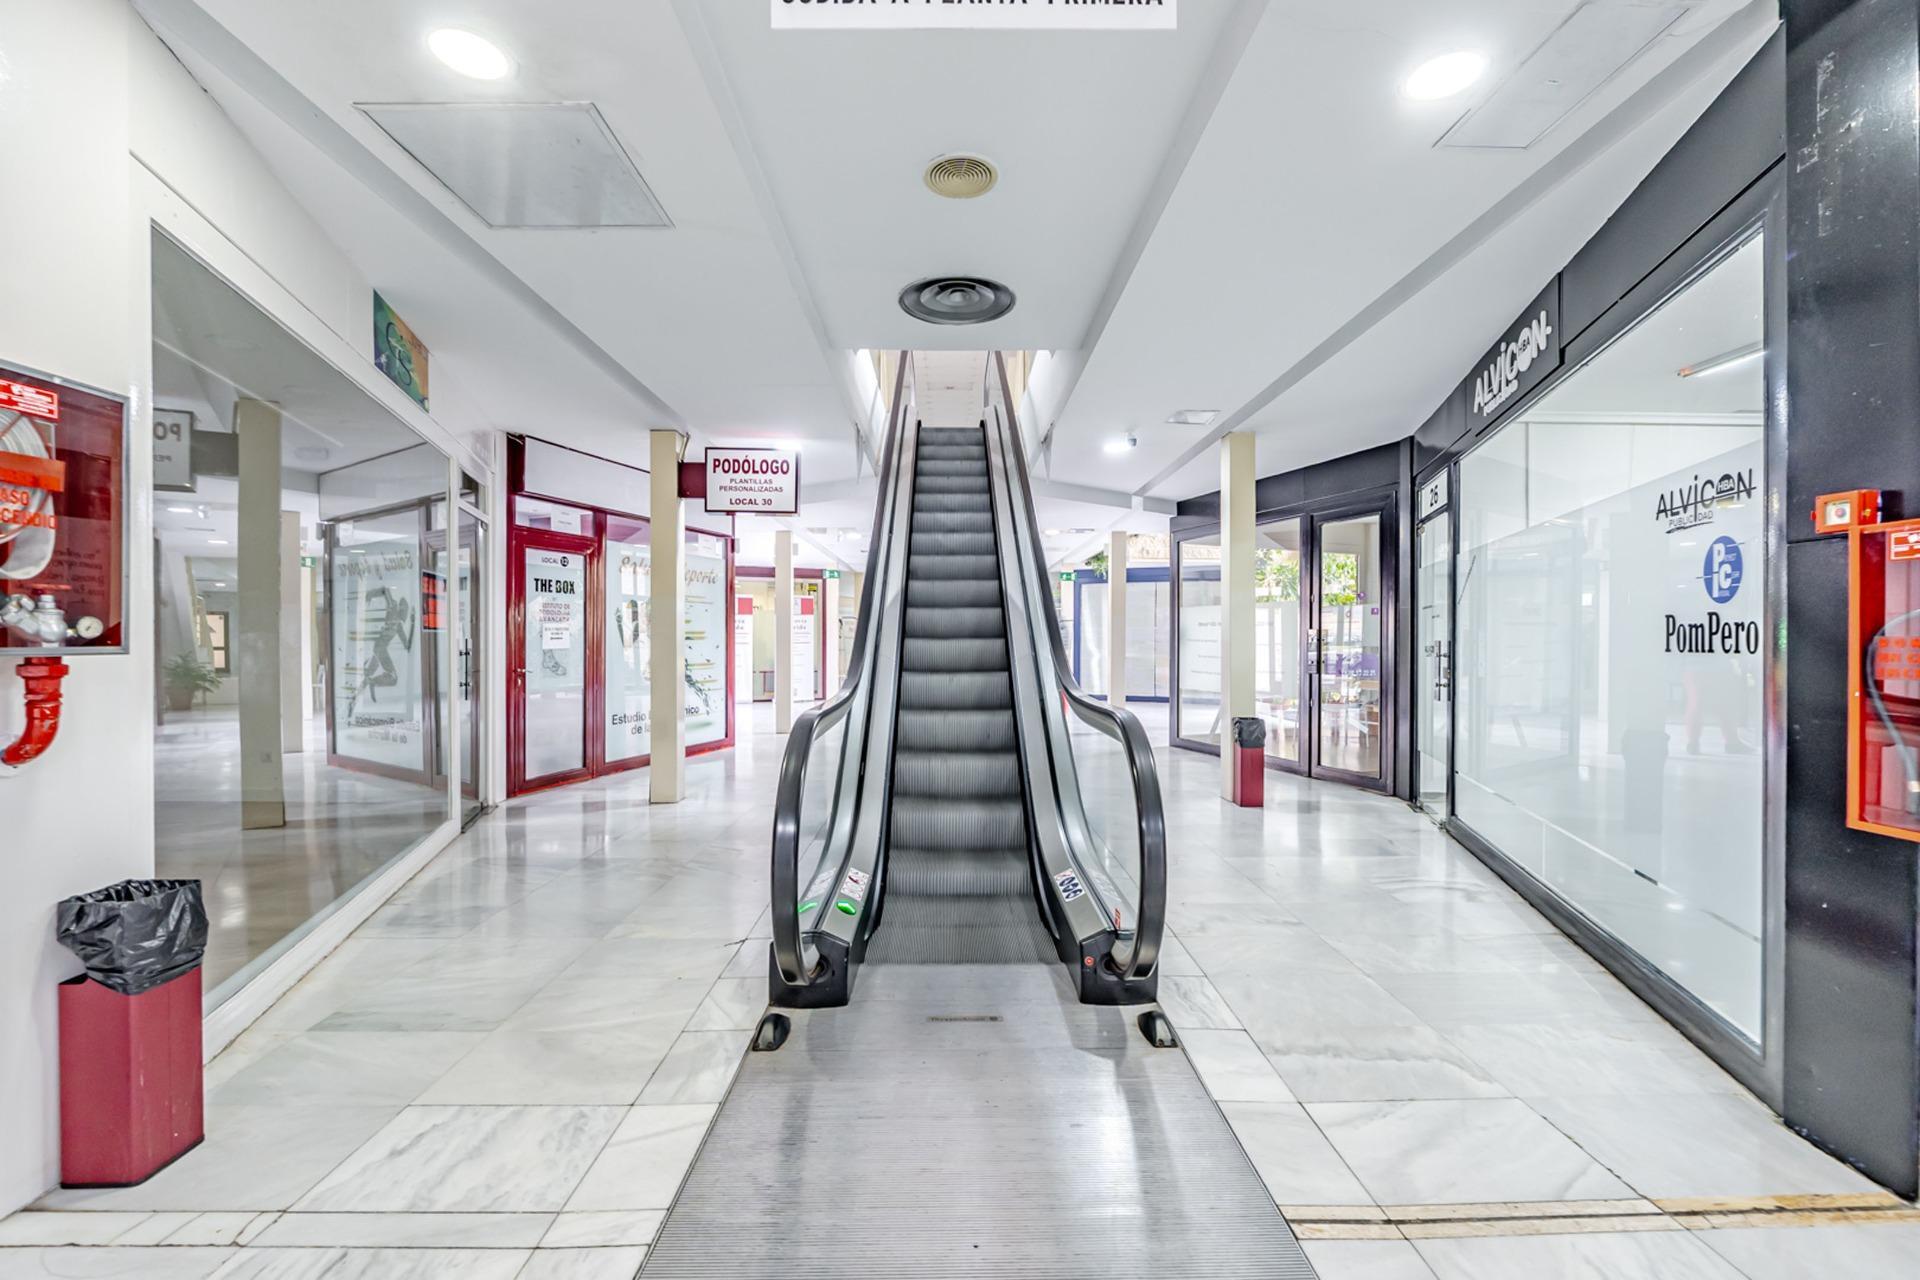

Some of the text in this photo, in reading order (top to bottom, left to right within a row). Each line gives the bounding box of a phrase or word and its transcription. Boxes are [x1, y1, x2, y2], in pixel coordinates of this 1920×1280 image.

[712, 455, 790, 475] PODÓLOGO
[0, 488, 29, 506] ASO
[719, 485, 784, 493] PERSONALIZADAS
[1429, 484, 1439, 507] 26
[729, 498, 773, 506] LOCAL 30
[534, 578, 575, 595] THE BOX
[1664, 612, 1759, 654] PomPero
[612, 711, 646, 725] Estudio
[631, 726, 642, 735] de
